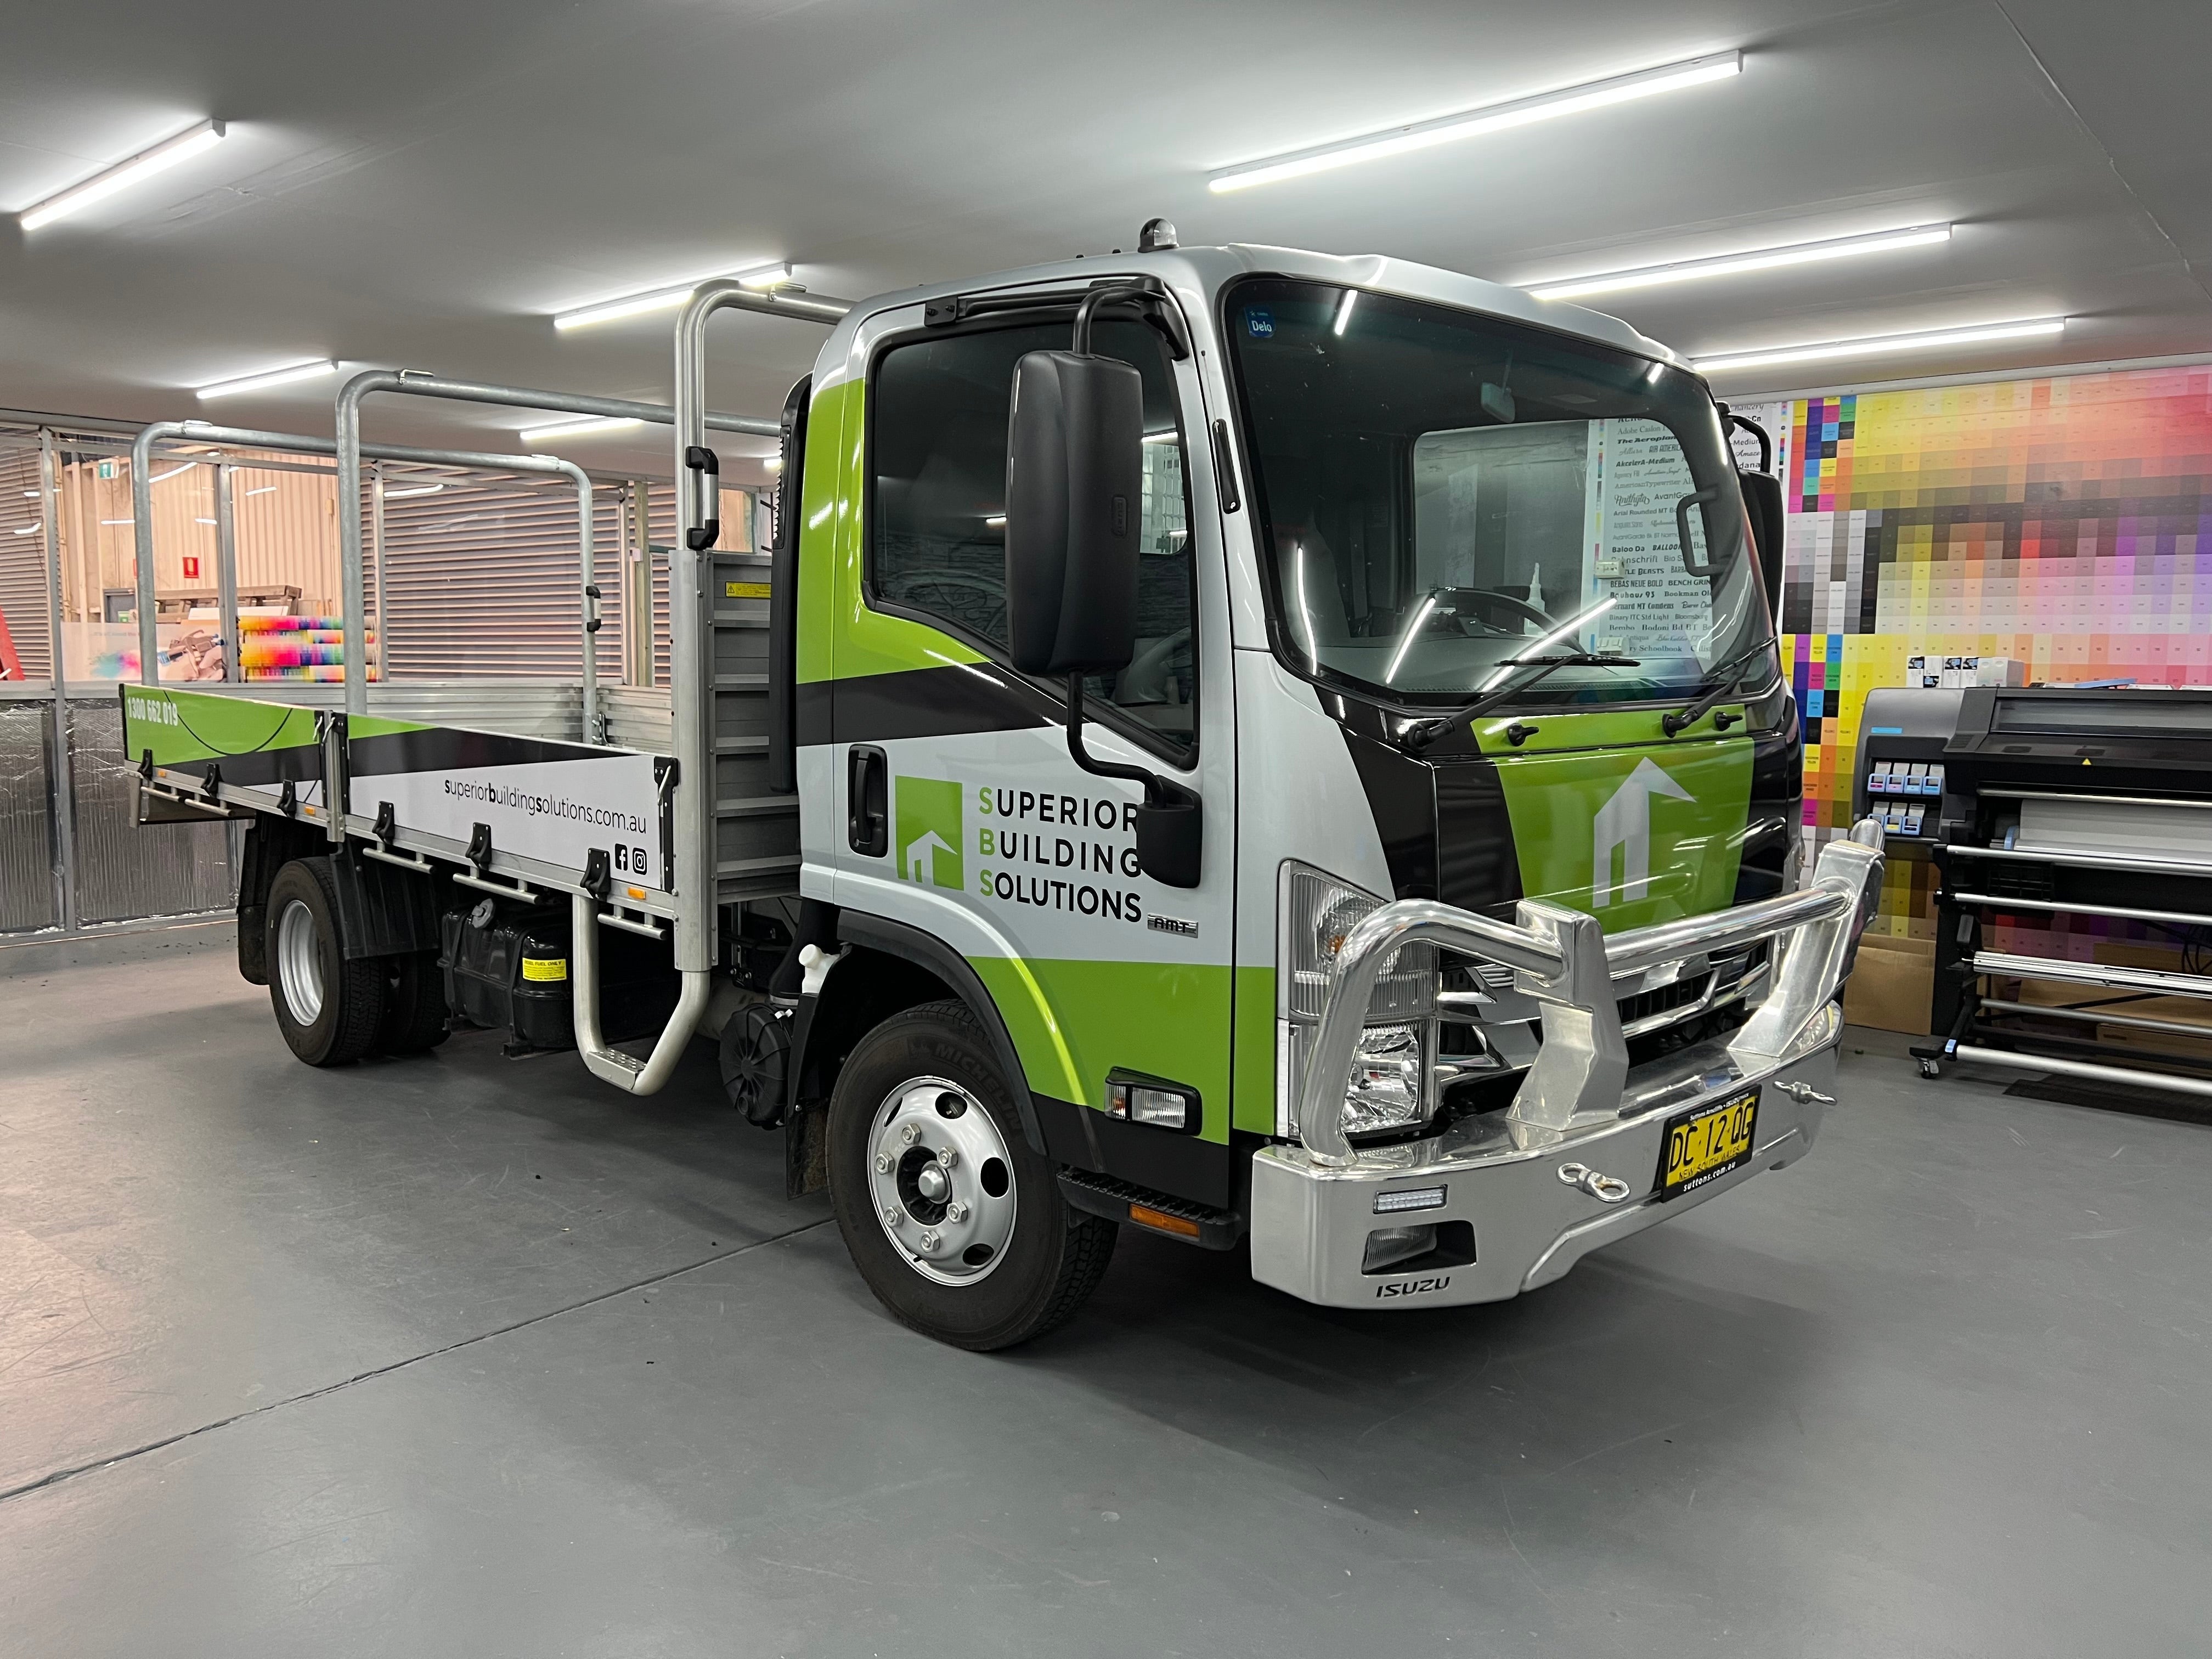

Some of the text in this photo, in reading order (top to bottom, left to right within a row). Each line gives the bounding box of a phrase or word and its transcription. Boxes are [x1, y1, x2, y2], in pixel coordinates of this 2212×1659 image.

[1251, 320, 1272, 332] Delo
[127, 697, 178, 726] 1300 662 019
[445, 780, 646, 834] superiorbuildingsolutions.com.au
[979, 787, 1137, 833] SUPERIOR
[980, 828, 1141, 878] BUILDING
[980, 869, 1142, 923] SOLUTIONS
[1154, 918, 1189, 933] AMT
[1669, 1126, 1698, 1173] DC
[1706, 1114, 1728, 1158] 12
[1679, 1144, 1740, 1180] NEW SOUTH WALES
[1684, 1161, 1736, 1192] suttons.com.au
[1376, 1277, 1450, 1298] ISUZU
